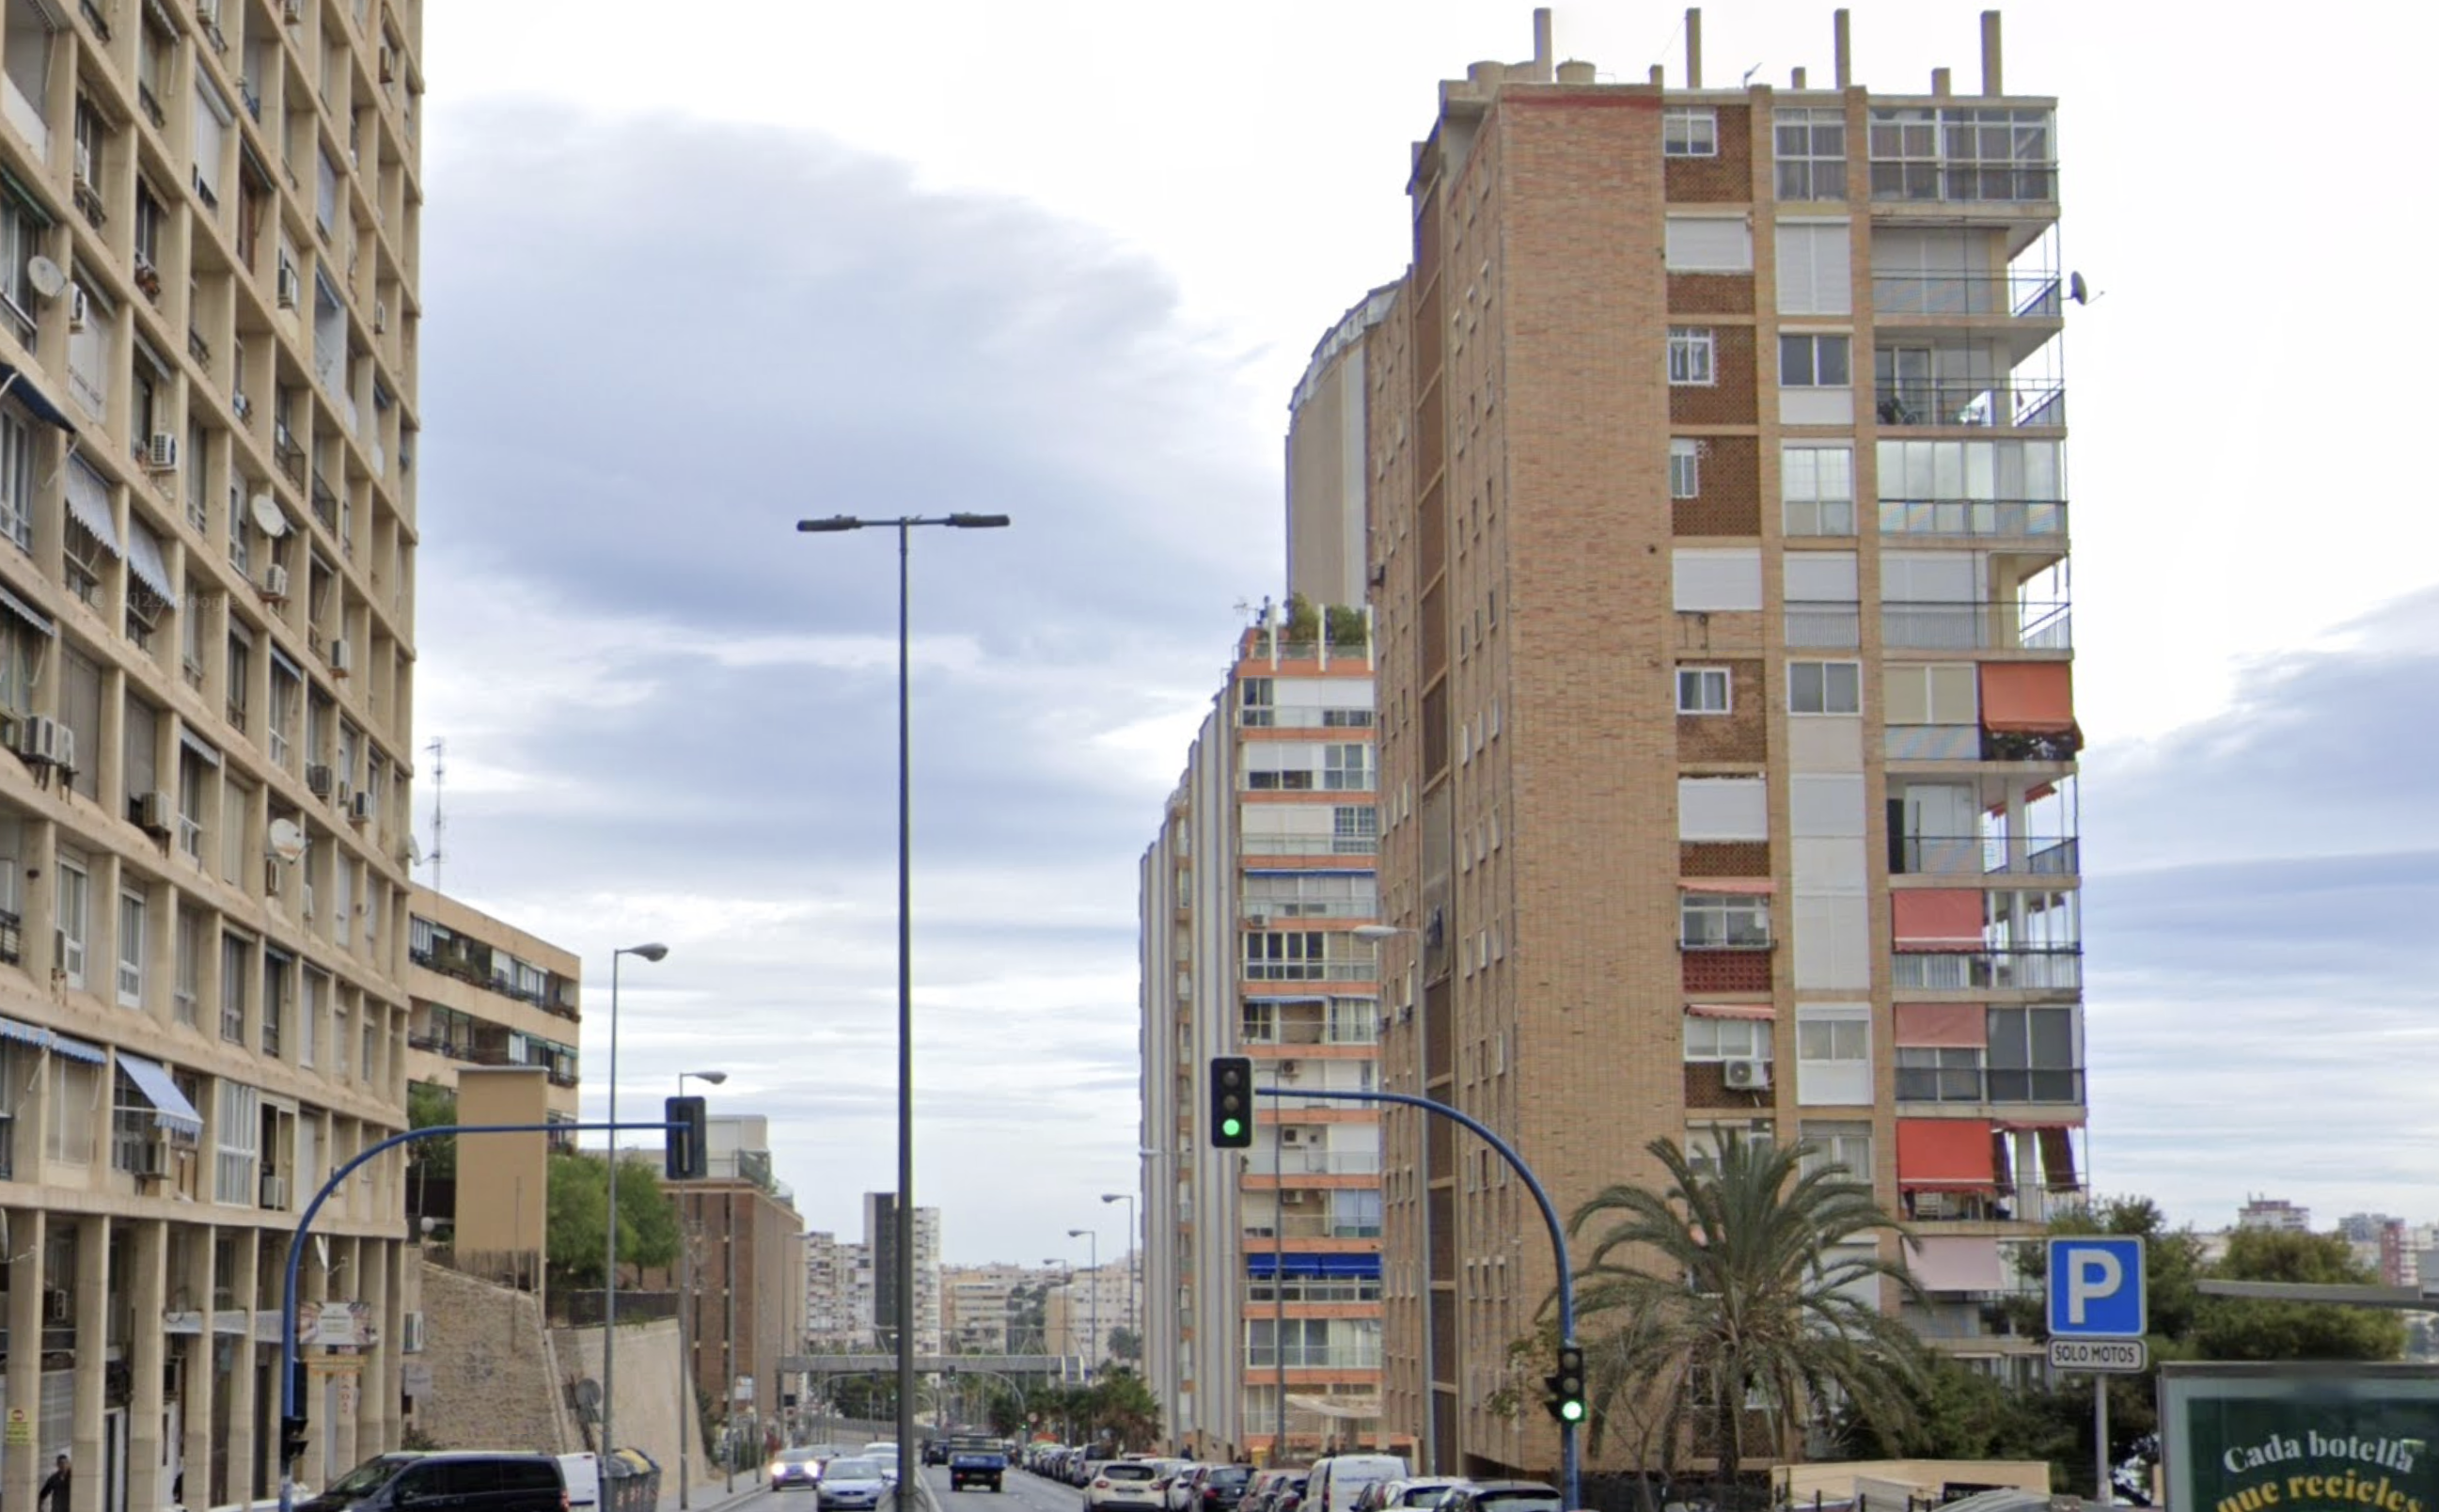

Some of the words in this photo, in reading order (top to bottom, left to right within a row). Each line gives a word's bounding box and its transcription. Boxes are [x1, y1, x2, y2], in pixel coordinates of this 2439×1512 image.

[2068, 1249, 2122, 1324] P
[2054, 1345, 2088, 1362] SOLO
[2091, 1346, 2134, 1362] MOTOS
[2224, 1434, 2301, 1473] Cada
[2308, 1430, 2414, 1473] botella
